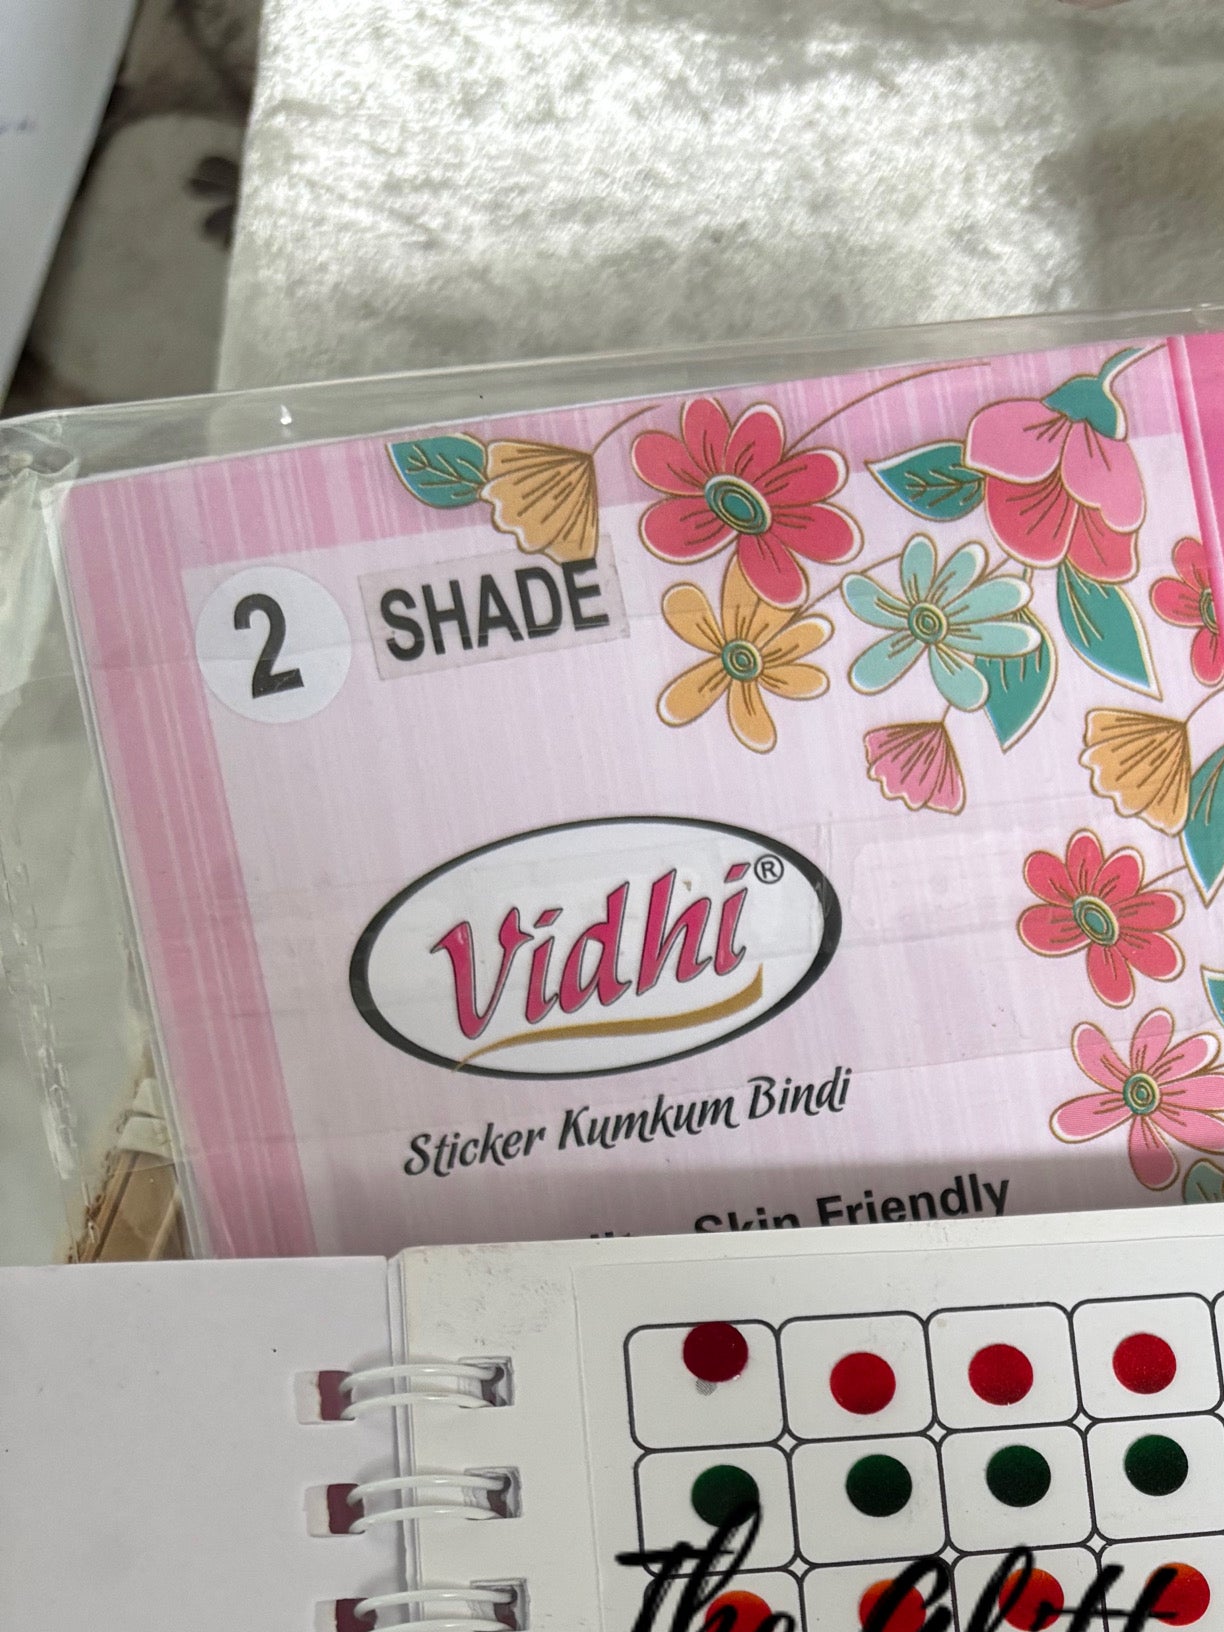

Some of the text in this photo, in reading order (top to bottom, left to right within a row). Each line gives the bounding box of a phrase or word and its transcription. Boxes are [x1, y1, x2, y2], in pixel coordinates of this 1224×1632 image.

[232, 556, 611, 699] 2 SHADE
[429, 862, 752, 1040] Vidhi
[403, 1067, 854, 1178] Sticker Kumkum Bindi
[815, 1172, 1011, 1227] Friendly
